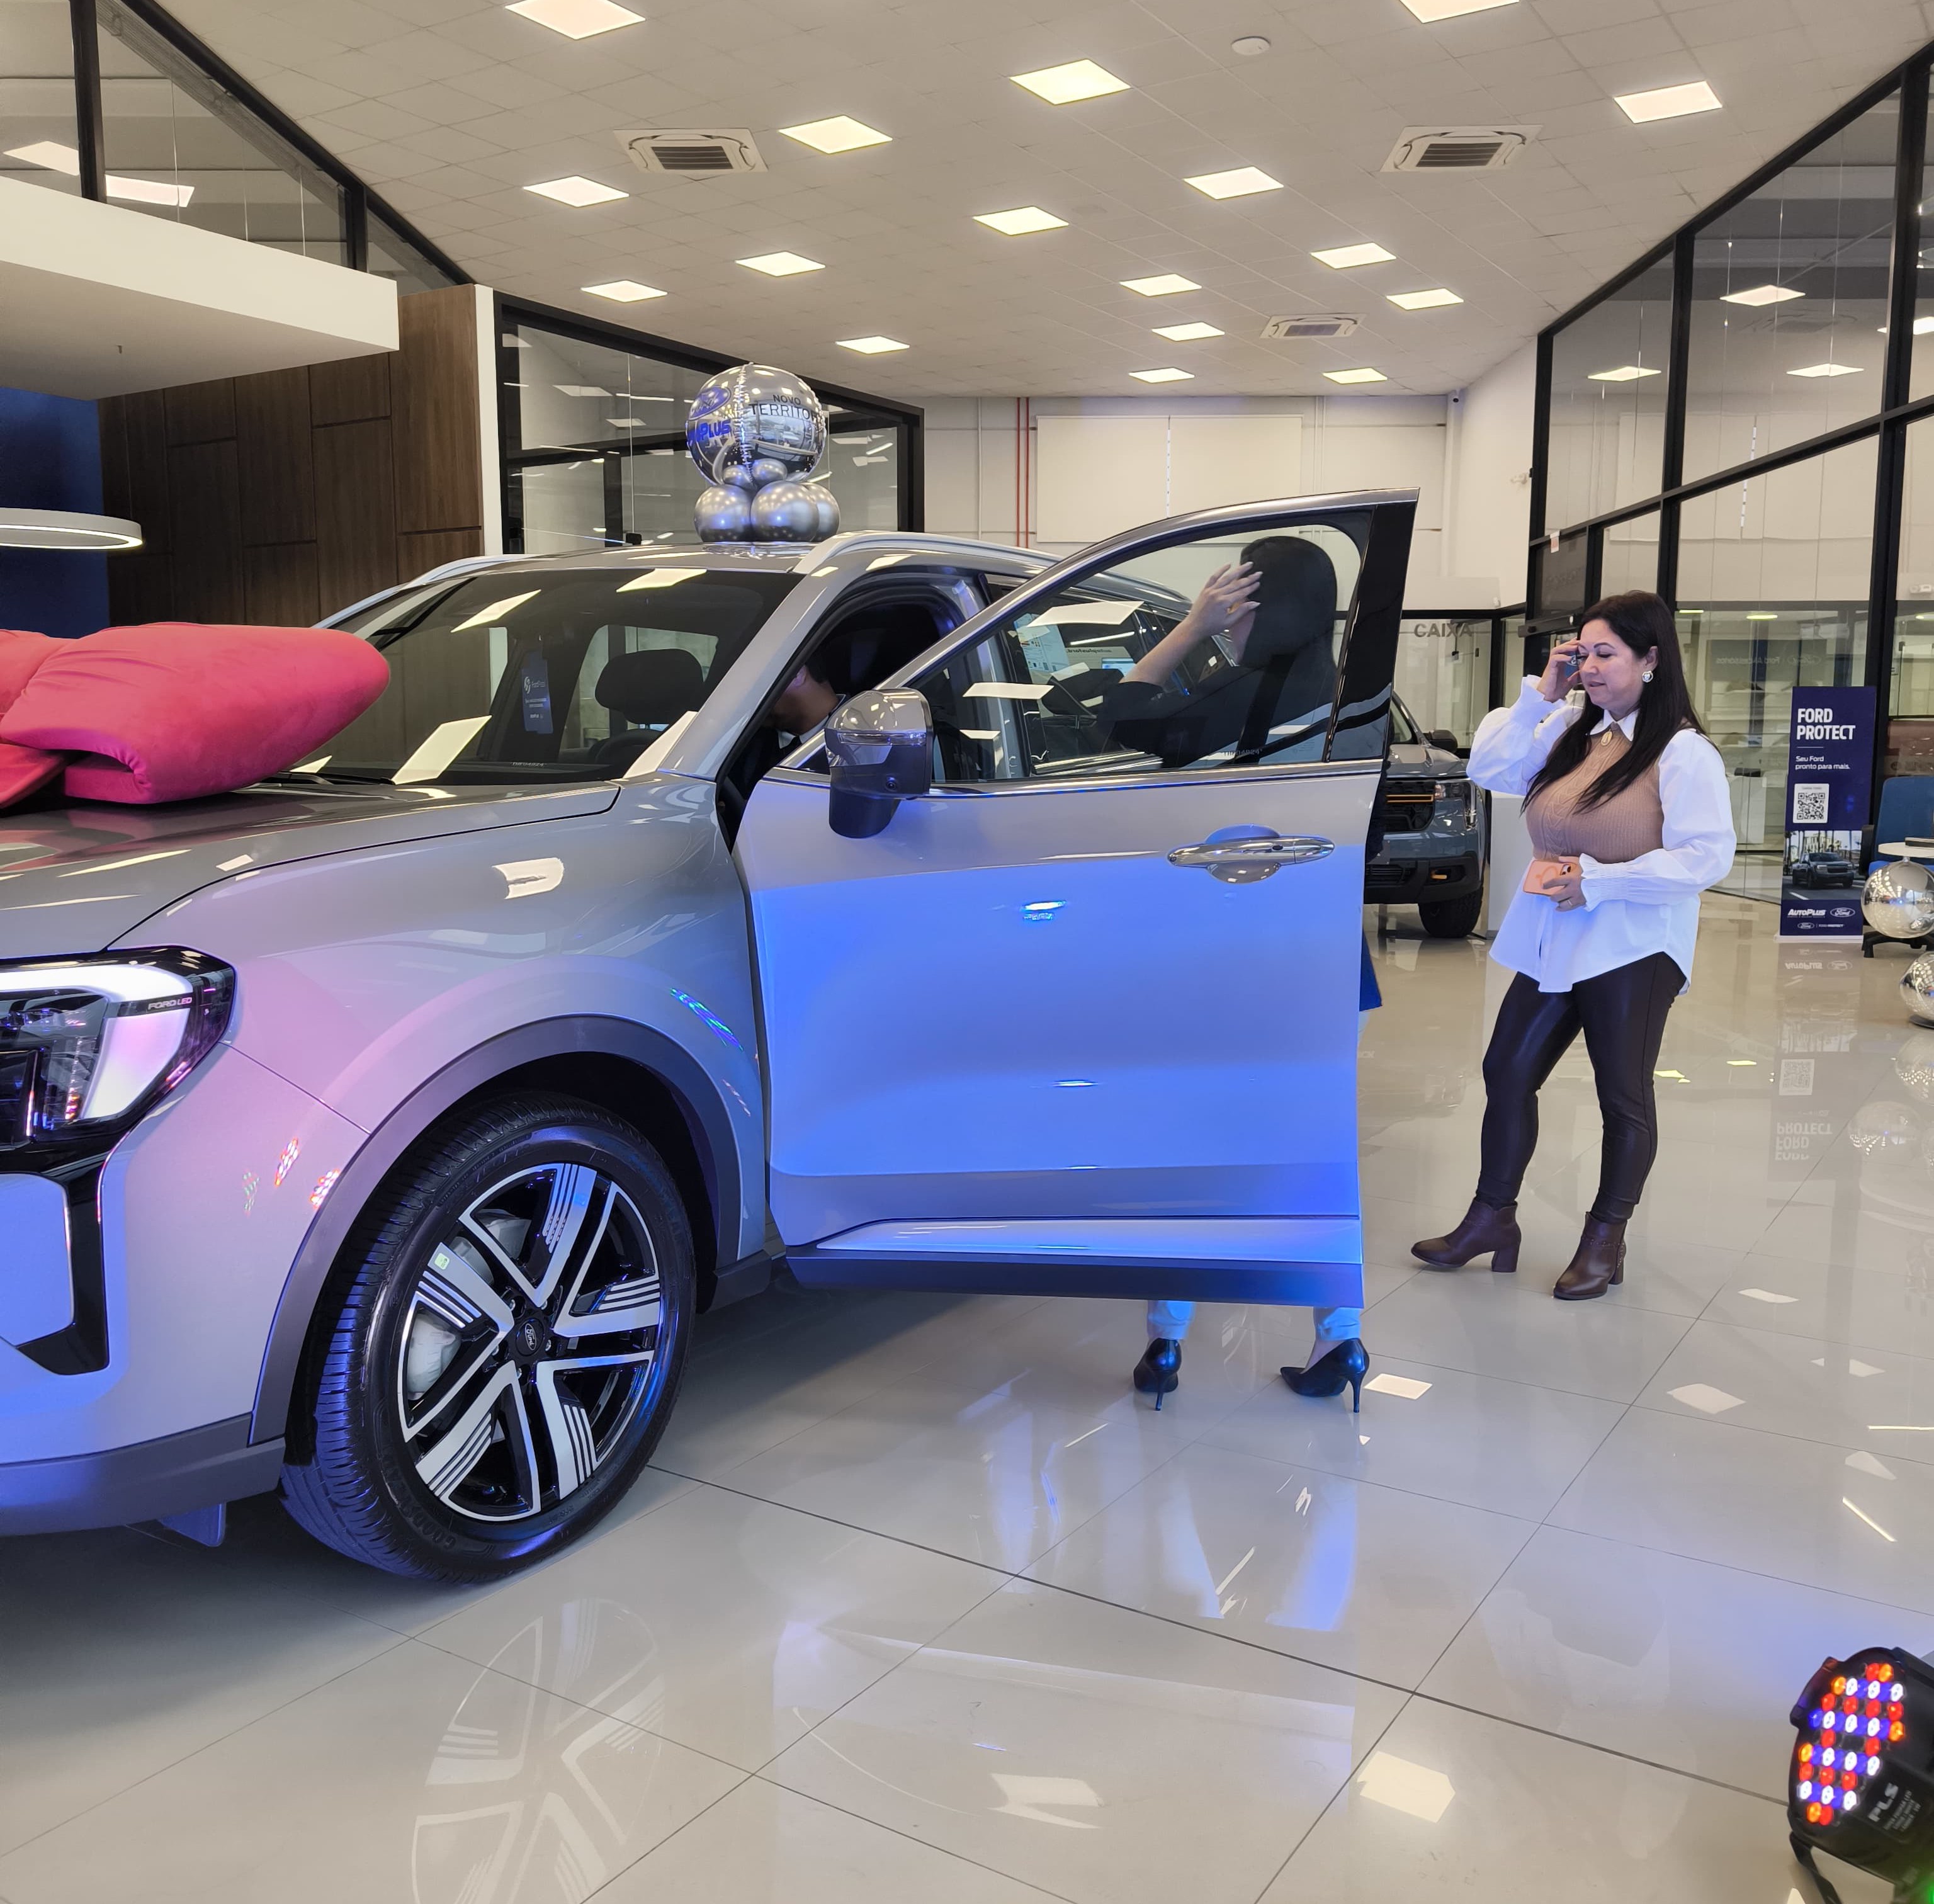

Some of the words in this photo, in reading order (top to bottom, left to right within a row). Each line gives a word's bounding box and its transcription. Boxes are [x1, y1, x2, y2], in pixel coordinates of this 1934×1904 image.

[772, 394, 801, 405] NOVO
[1414, 623, 1473, 637] CAIXA
[1797, 708, 1833, 723] FORD
[1796, 725, 1856, 740] PROTECT
[1833, 908, 1852, 917] Ford
[148, 999, 177, 1010] FORD
[177, 997, 193, 1006] LED
[526, 1327, 536, 1347] Ford
[1868, 1782, 1899, 1822] PLS
